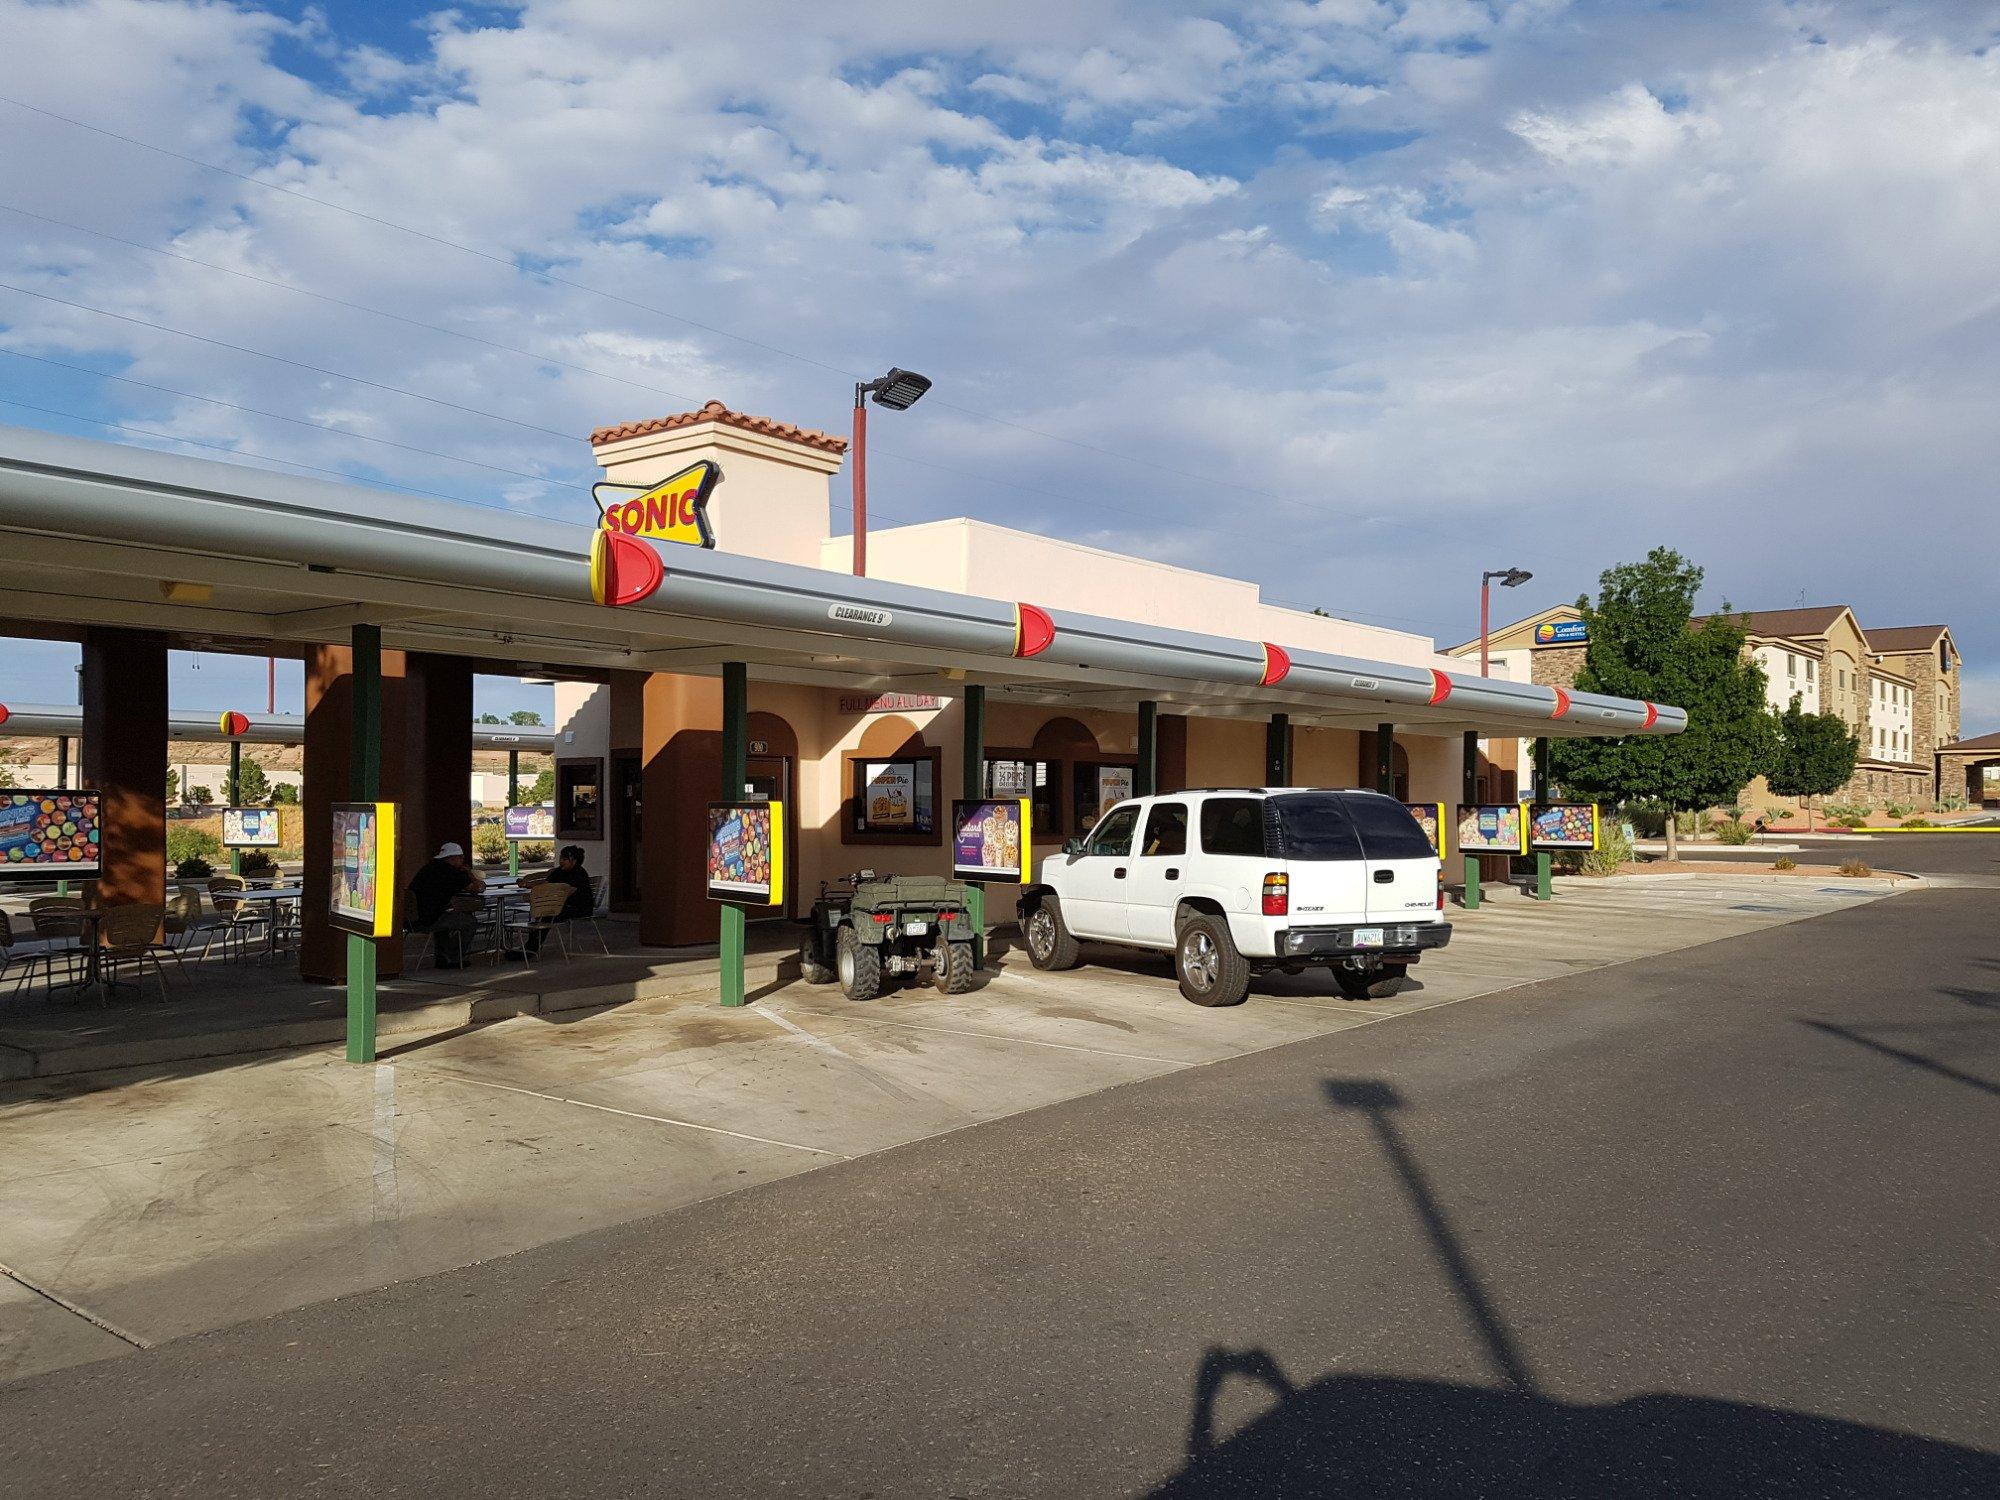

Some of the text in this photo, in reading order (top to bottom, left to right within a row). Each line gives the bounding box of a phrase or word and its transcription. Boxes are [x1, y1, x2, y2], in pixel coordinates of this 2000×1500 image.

[606, 489, 697, 534] SONIC
[835, 606, 877, 622] CLEARANCE
[840, 694, 935, 711] FULL MENU ALL DAY
